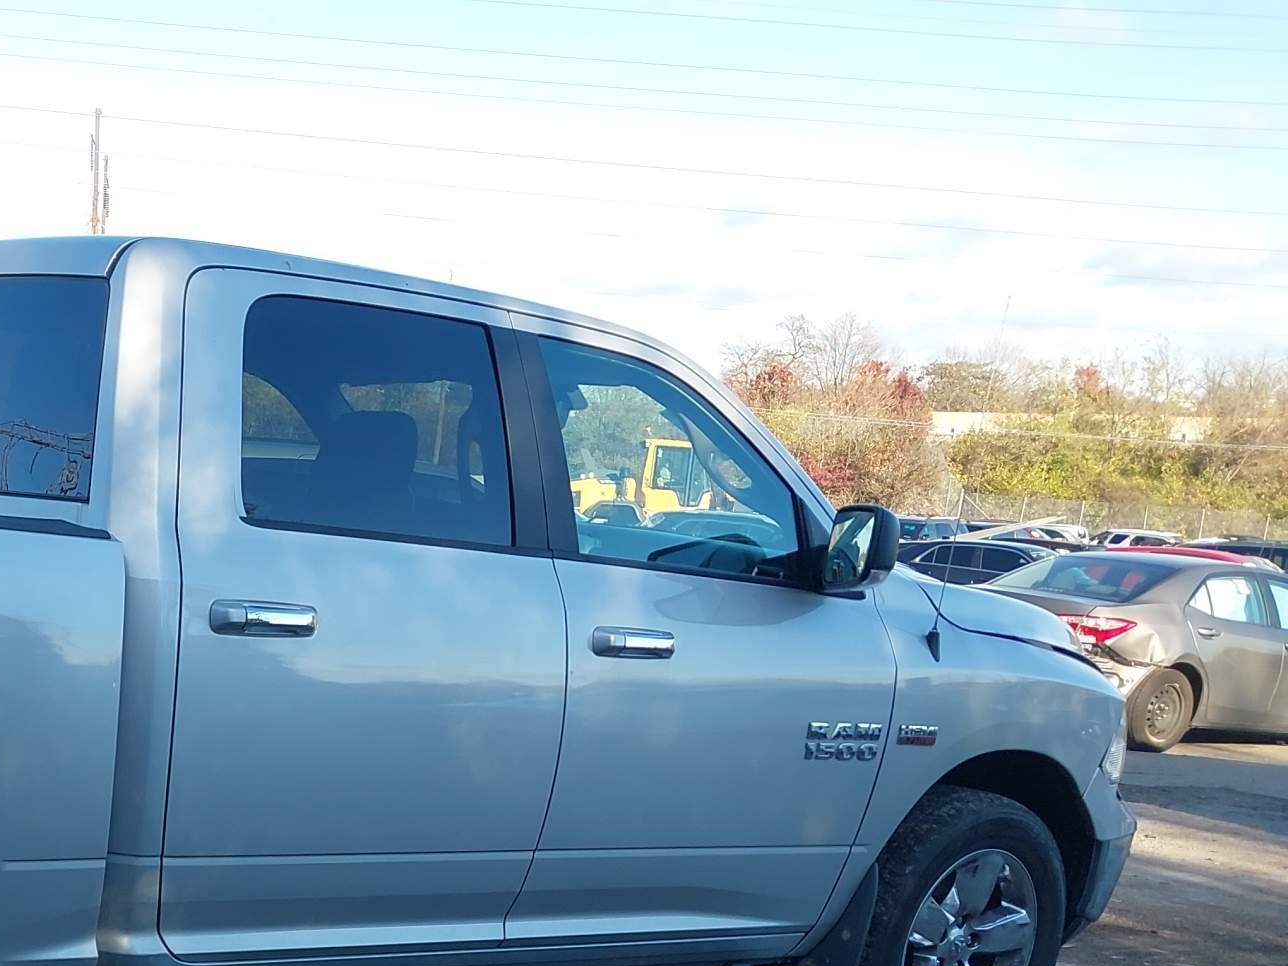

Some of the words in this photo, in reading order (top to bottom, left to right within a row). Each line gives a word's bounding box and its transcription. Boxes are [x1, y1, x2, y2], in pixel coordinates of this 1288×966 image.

[806, 721, 883, 741] RAM
[897, 724, 939, 737] HEMI
[804, 742, 878, 761] 1500
